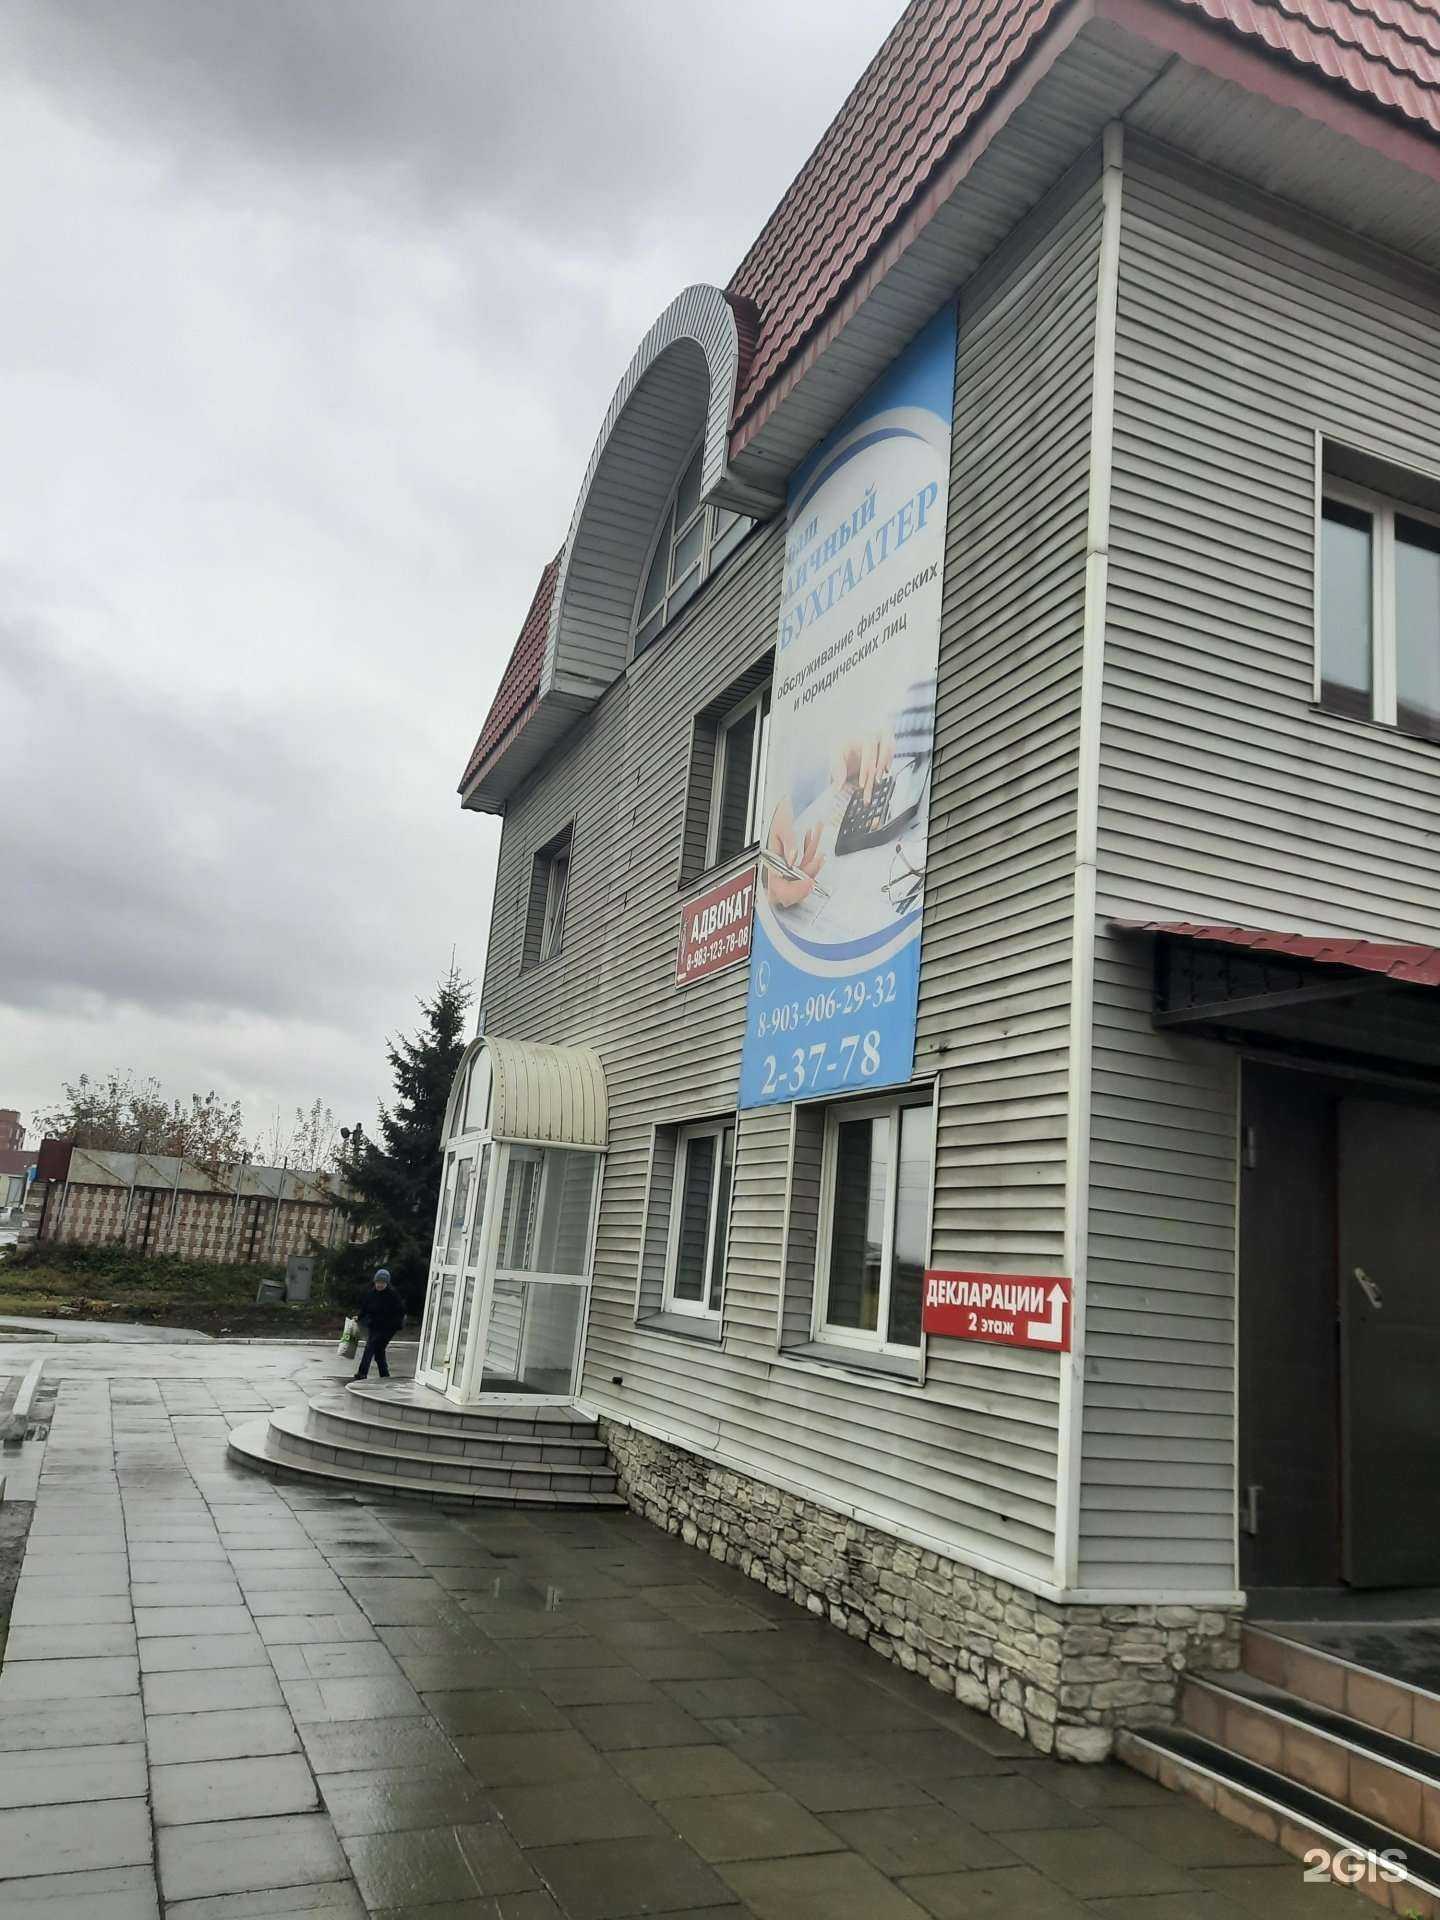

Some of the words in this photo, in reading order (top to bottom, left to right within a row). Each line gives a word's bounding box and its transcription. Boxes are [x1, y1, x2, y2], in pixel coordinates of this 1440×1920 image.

[780, 481, 938, 651] БУХГАЛТЕР
[777, 630, 854, 700] обслуживание
[856, 561, 939, 642] физических
[793, 699, 800, 712] и
[802, 637, 879, 706] юридических
[881, 613, 908, 646] лиц
[690, 885, 753, 944] АДВОКАТ
[686, 926, 749, 972] 8-983-123-78-08
[758, 971, 896, 1038] 8-903-906-29-32
[761, 1030, 881, 1094] 2-37-78
[926, 1279, 1044, 1315] ДЕКЛАРАЦИИ
[968, 1312, 978, 1331] 2
[980, 1318, 1014, 1336] этаж
